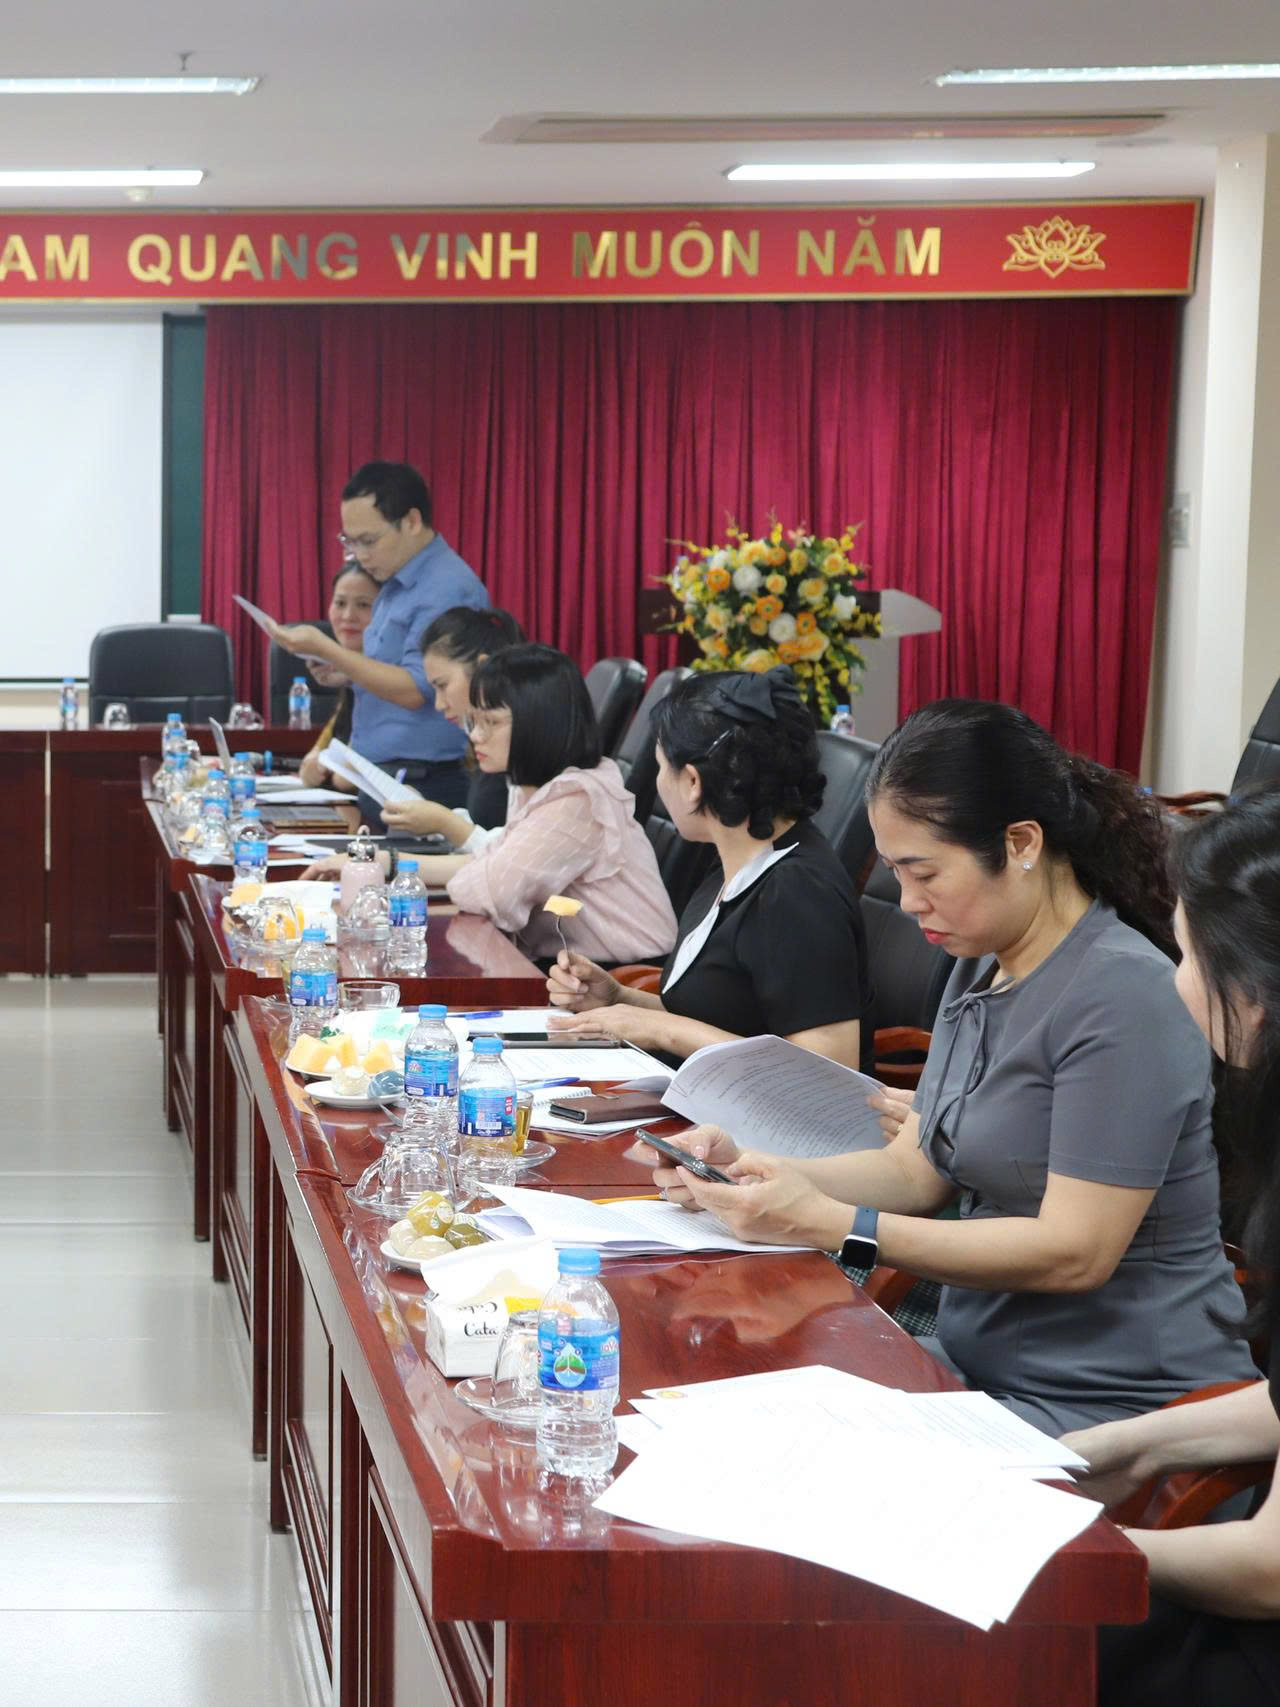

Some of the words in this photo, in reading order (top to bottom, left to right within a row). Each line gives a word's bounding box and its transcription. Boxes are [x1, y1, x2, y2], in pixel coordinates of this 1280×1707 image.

[126, 230, 360, 288] QUANG
[387, 230, 541, 281] VINH
[572, 219, 761, 279] MUÔN
[796, 215, 943, 278] NĂM
